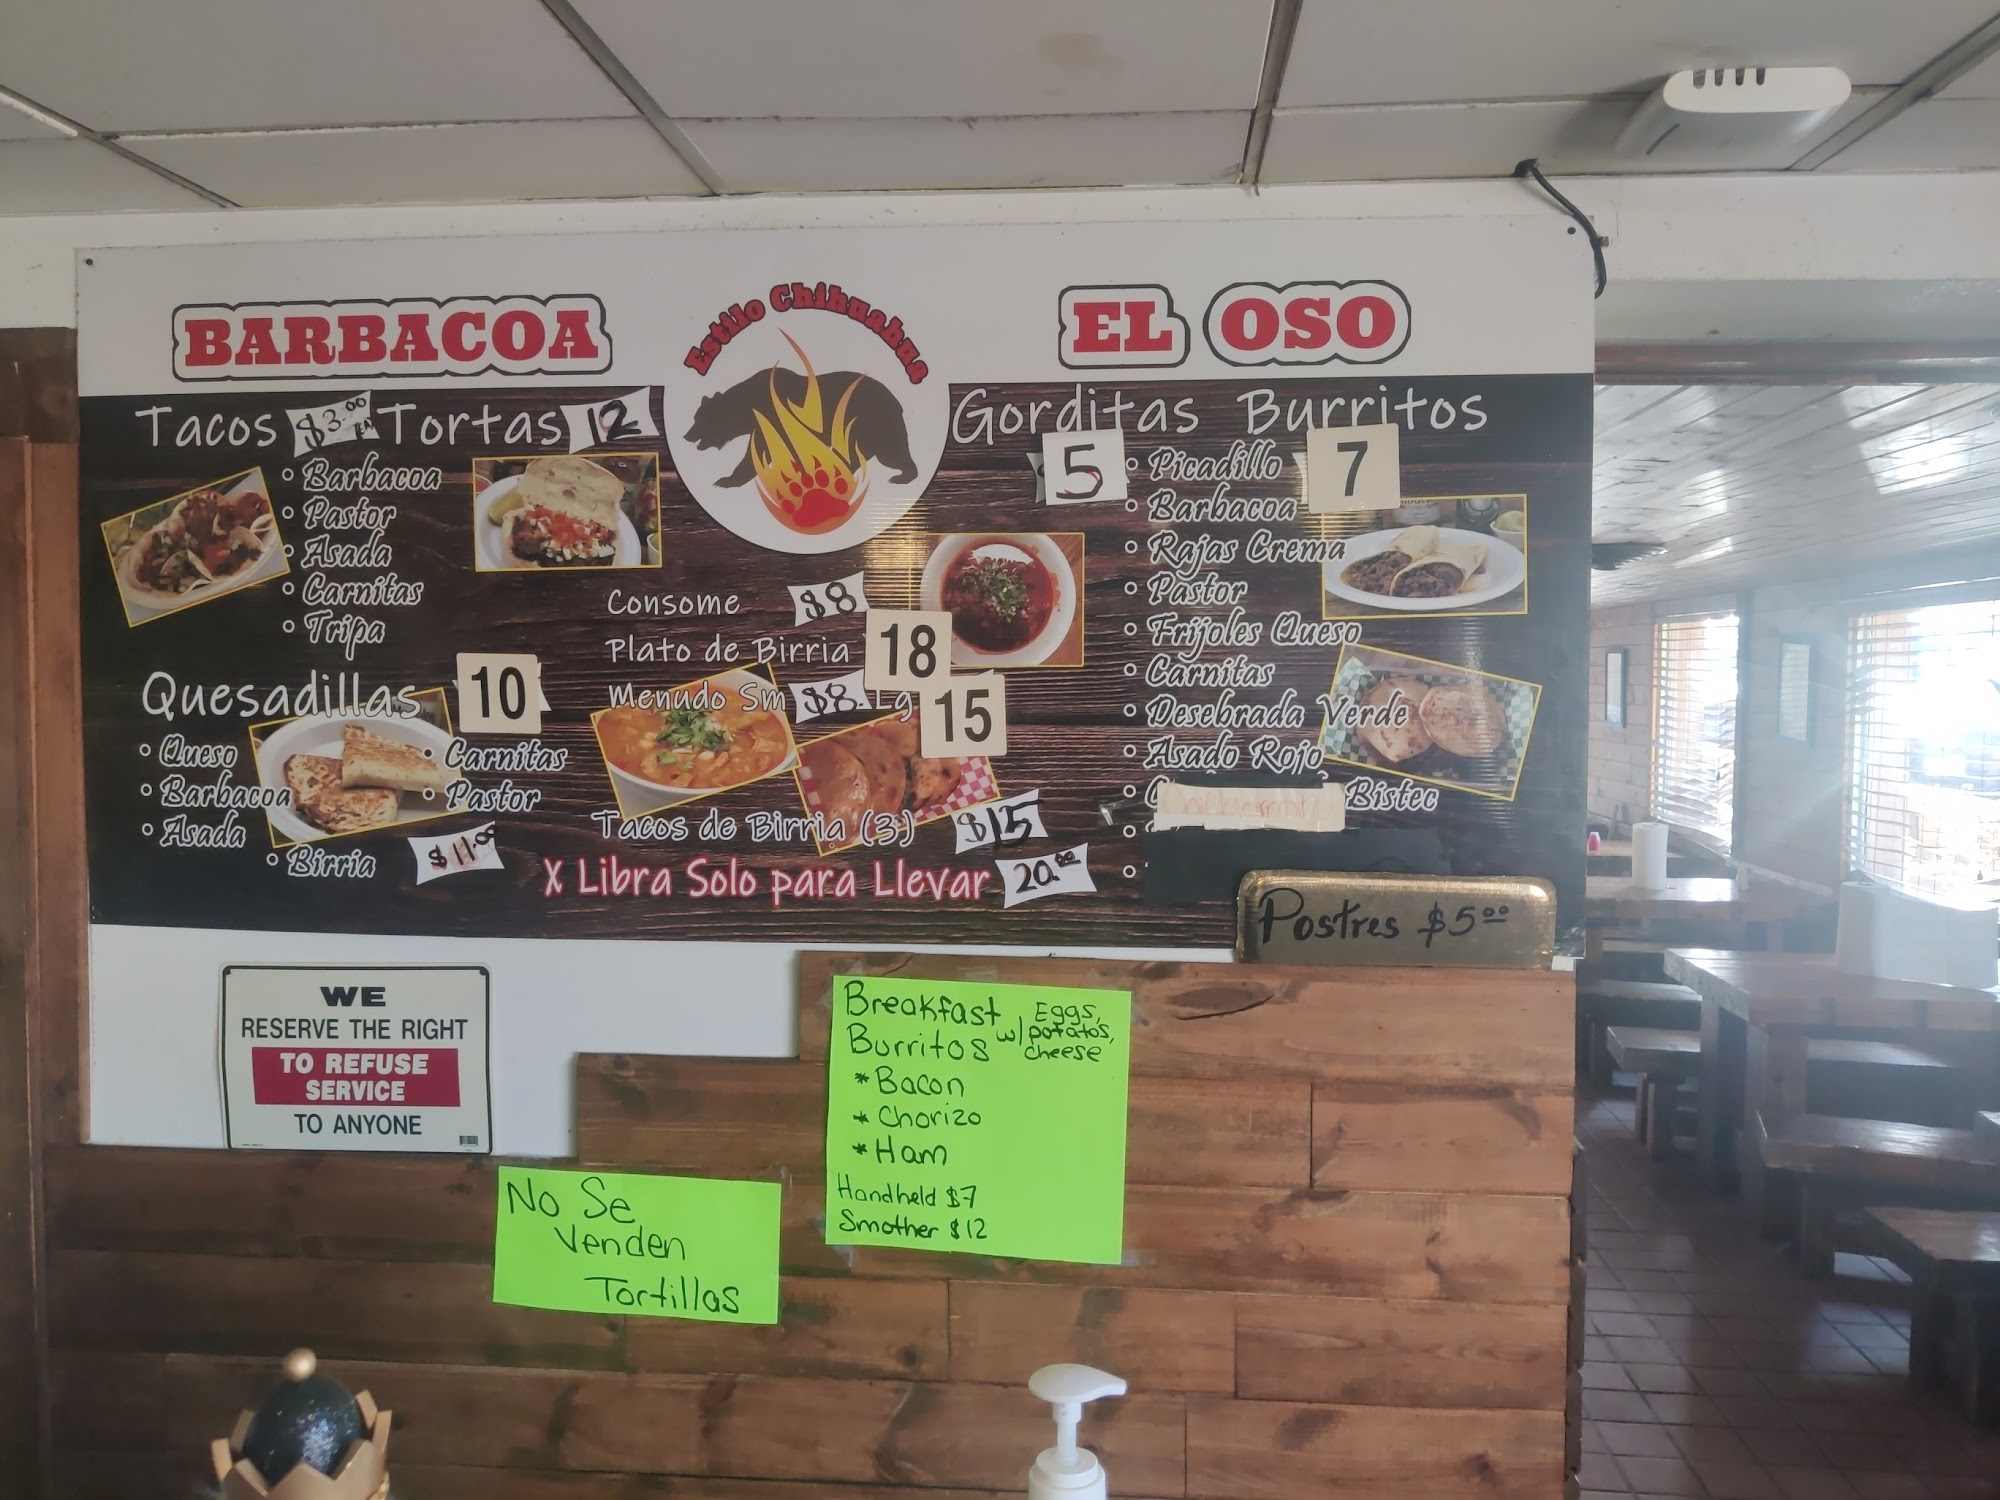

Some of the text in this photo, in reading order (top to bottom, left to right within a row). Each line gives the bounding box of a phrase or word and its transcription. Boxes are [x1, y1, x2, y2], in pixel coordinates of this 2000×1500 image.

[184, 310, 599, 366] BARBACOA
[683, 281, 929, 385] Estilo Chihuahua
[1073, 295, 1397, 353] EL OSO
[135, 404, 278, 448] Tacos
[377, 402, 563, 448] Tortas
[587, 400, 642, 442] 12
[951, 382, 1489, 446] Gorditas Burritos
[302, 451, 441, 493] Barbacoa
[1056, 443, 1103, 499] 5
[1147, 439, 1283, 482] Picadillo
[1337, 440, 1369, 497] 7
[303, 496, 397, 532] Pastor
[1147, 481, 1297, 523] Barbacoa
[301, 528, 392, 569] Asada
[1147, 530, 1346, 577] Rajas Crema
[302, 567, 424, 606] Carnitas
[607, 589, 740, 616] Consome
[800, 582, 857, 622] $8
[1146, 571, 1248, 606] Pastor
[304, 611, 385, 661] Tripa
[605, 634, 850, 664] Plato de Birria
[880, 623, 936, 678] 18
[1146, 610, 1361, 661] Frijoles Queso
[1145, 655, 1275, 689] Carnitas
[141, 669, 423, 719] Quesadillas
[470, 665, 526, 720] 10
[608, 681, 786, 712] Menudo Sm
[876, 690, 913, 723] Lg
[1145, 689, 1408, 729] Desebrada Verde
[934, 688, 992, 743] 15
[158, 734, 238, 770] Queso
[444, 738, 567, 773] Carnitas
[1143, 731, 1324, 778] Asado Rojo
[161, 772, 292, 808] Barbacoa
[446, 779, 540, 812] Pastor
[1344, 776, 1439, 812] Bistec
[160, 810, 246, 849] Asada
[592, 807, 916, 847] Tacos de Birria (3)
[956, 800, 1044, 848] $15
[287, 845, 375, 878] Birria
[543, 855, 991, 906] X Libra Solo para Llevar
[1258, 887, 1400, 944] Postres
[320, 986, 386, 1007] WE
[844, 980, 1001, 1027] Breakfast
[242, 1018, 468, 1040] RESERVE THE RIGHT
[847, 1023, 990, 1062] Burritos
[996, 1016, 1023, 1045] w/
[280, 1052, 429, 1075] TO REFUSE
[875, 1065, 965, 1097] Bacon
[306, 1080, 406, 1101] SERVICE
[294, 1114, 423, 1135] TO ANYONE
[879, 1102, 981, 1130] Chorizo
[875, 1134, 948, 1166] Ham
[507, 1176, 636, 1223] No Se
[837, 1172, 977, 1209] Handheld $7
[554, 1224, 685, 1260] Venden
[838, 1209, 988, 1240] Smother $12
[584, 1275, 739, 1314] Tortillas
